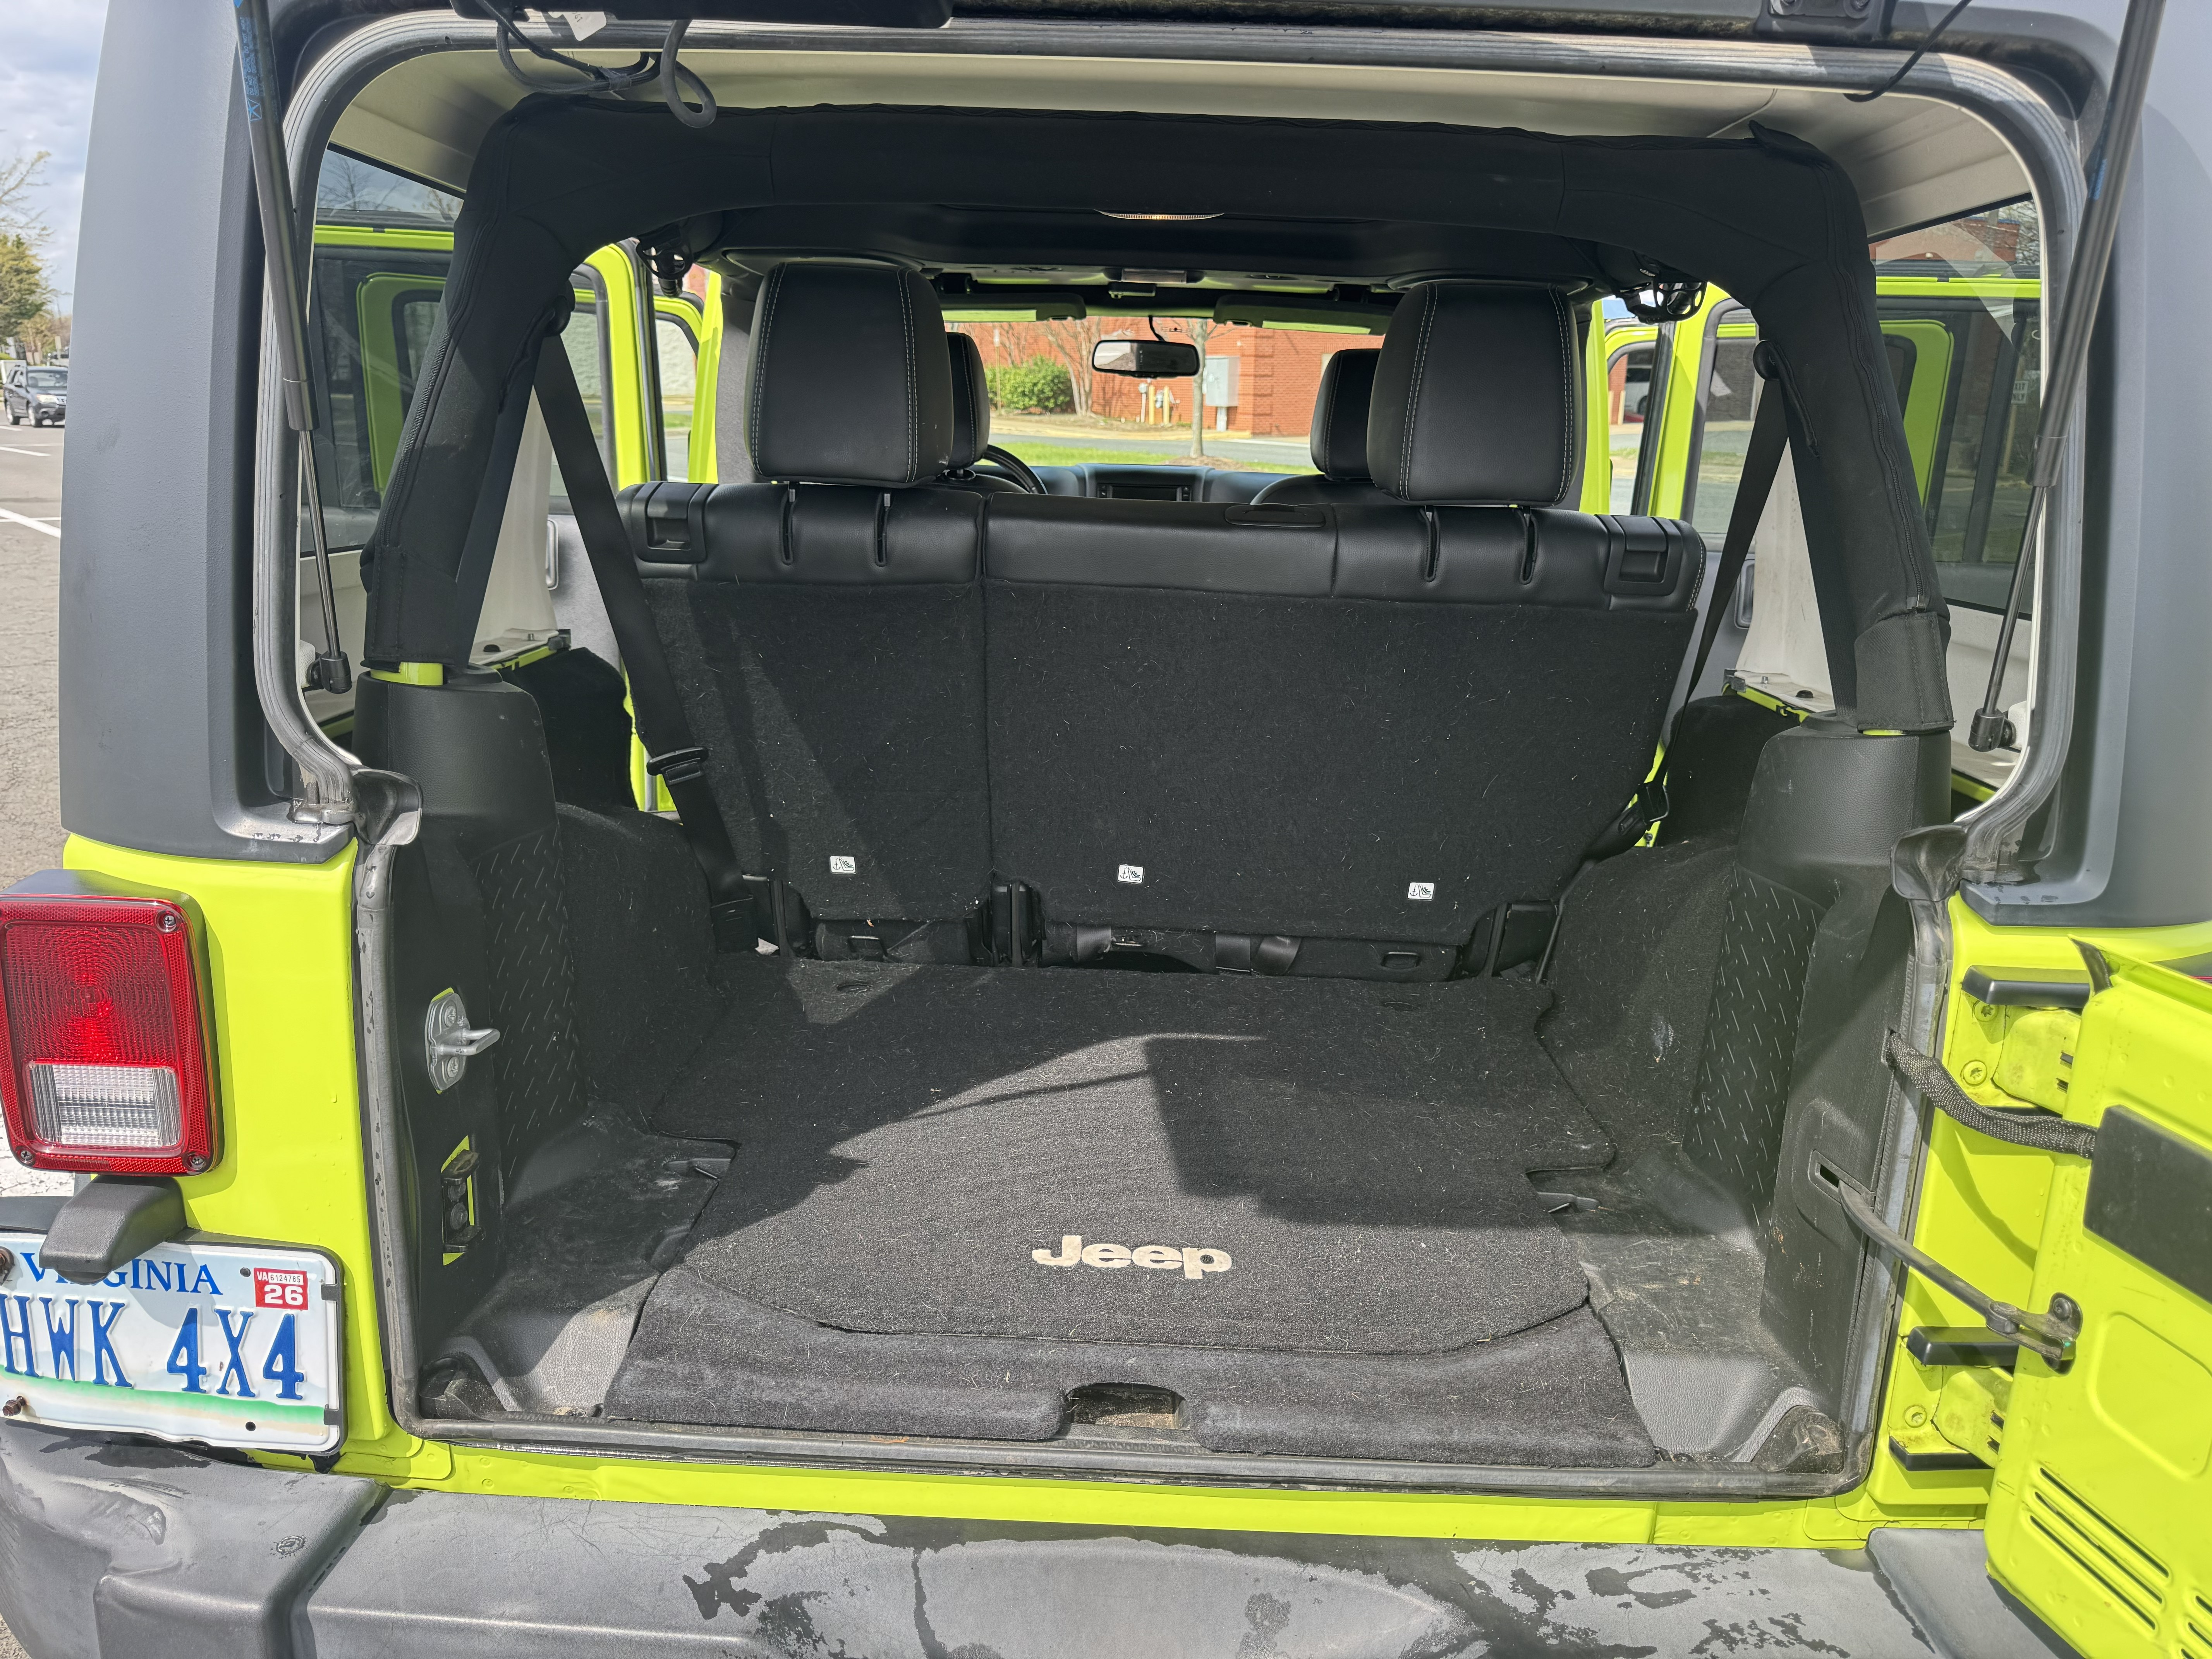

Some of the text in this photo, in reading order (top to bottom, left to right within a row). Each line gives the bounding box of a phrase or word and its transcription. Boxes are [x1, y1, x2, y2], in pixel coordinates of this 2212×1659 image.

[1032, 1235, 1232, 1279] Jeep
[256, 1271, 301, 1283] VA 6124785
[264, 1284, 303, 1305] 26
[0, 1293, 304, 1400] HWK 4X4
